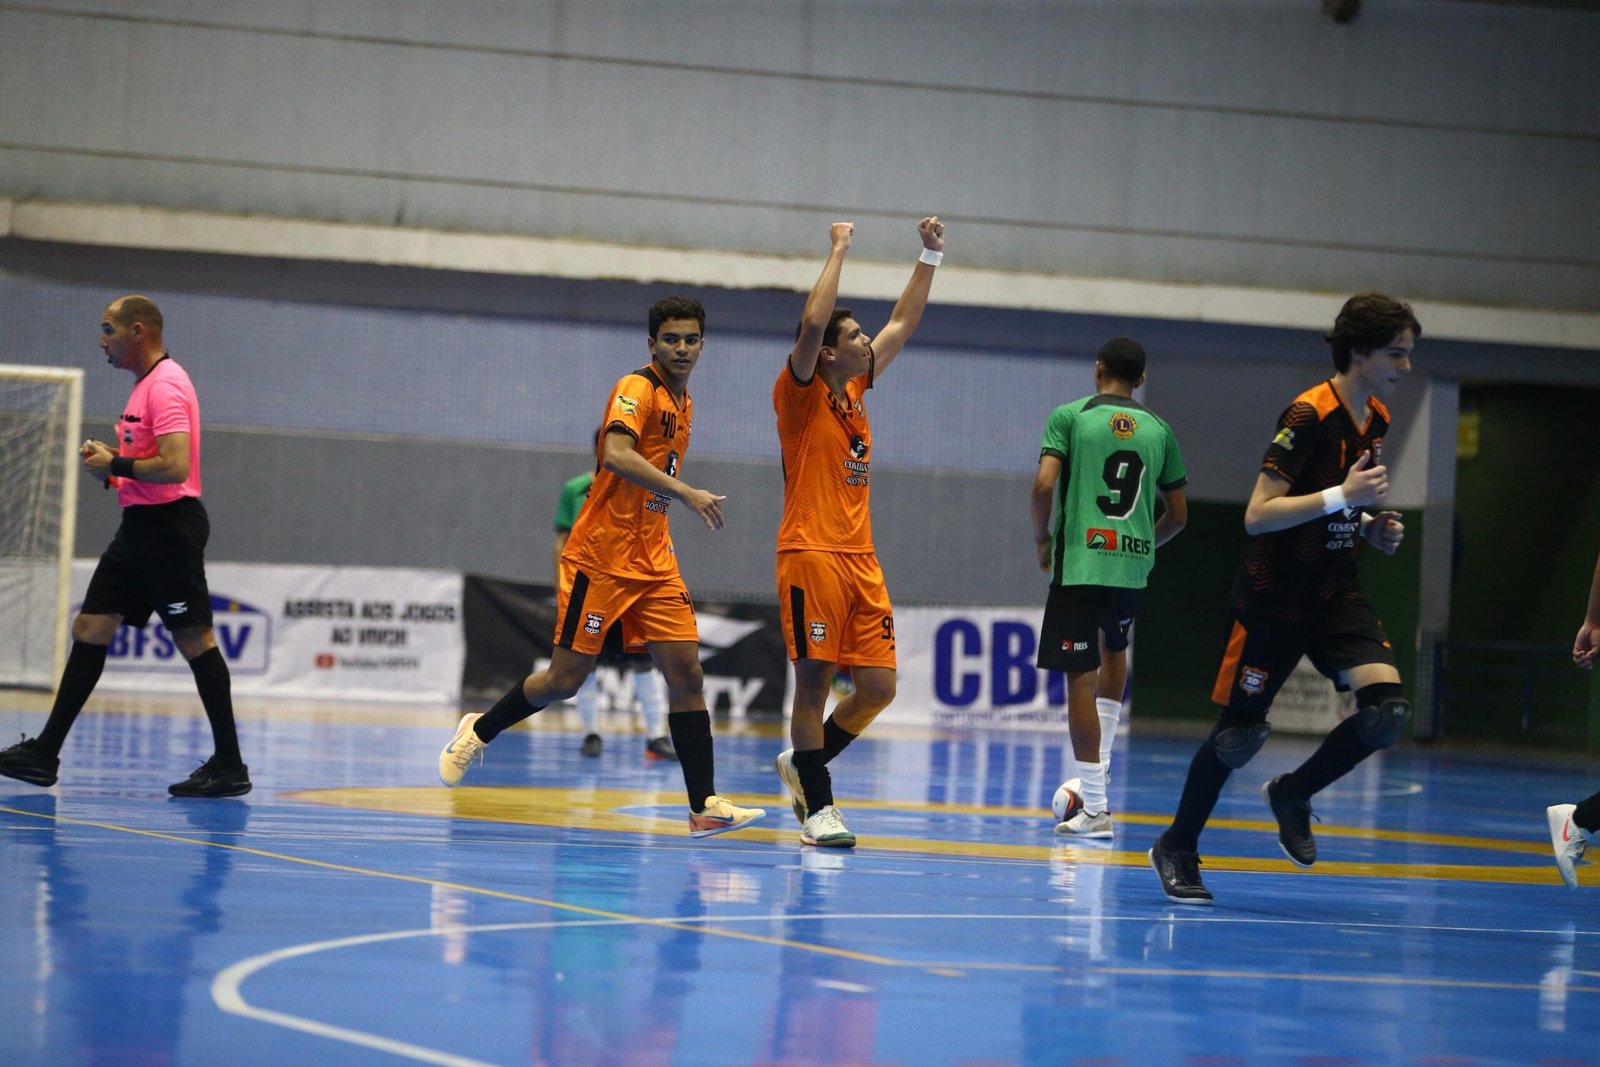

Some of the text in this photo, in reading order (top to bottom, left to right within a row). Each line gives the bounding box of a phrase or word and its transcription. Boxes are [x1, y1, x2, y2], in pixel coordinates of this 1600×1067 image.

[661, 410, 677, 439] 40
[1096, 450, 1146, 520] 9
[1121, 534, 1151, 555] REIS
[588, 620, 600, 628] 10
[1074, 641, 1089, 651] REIS
